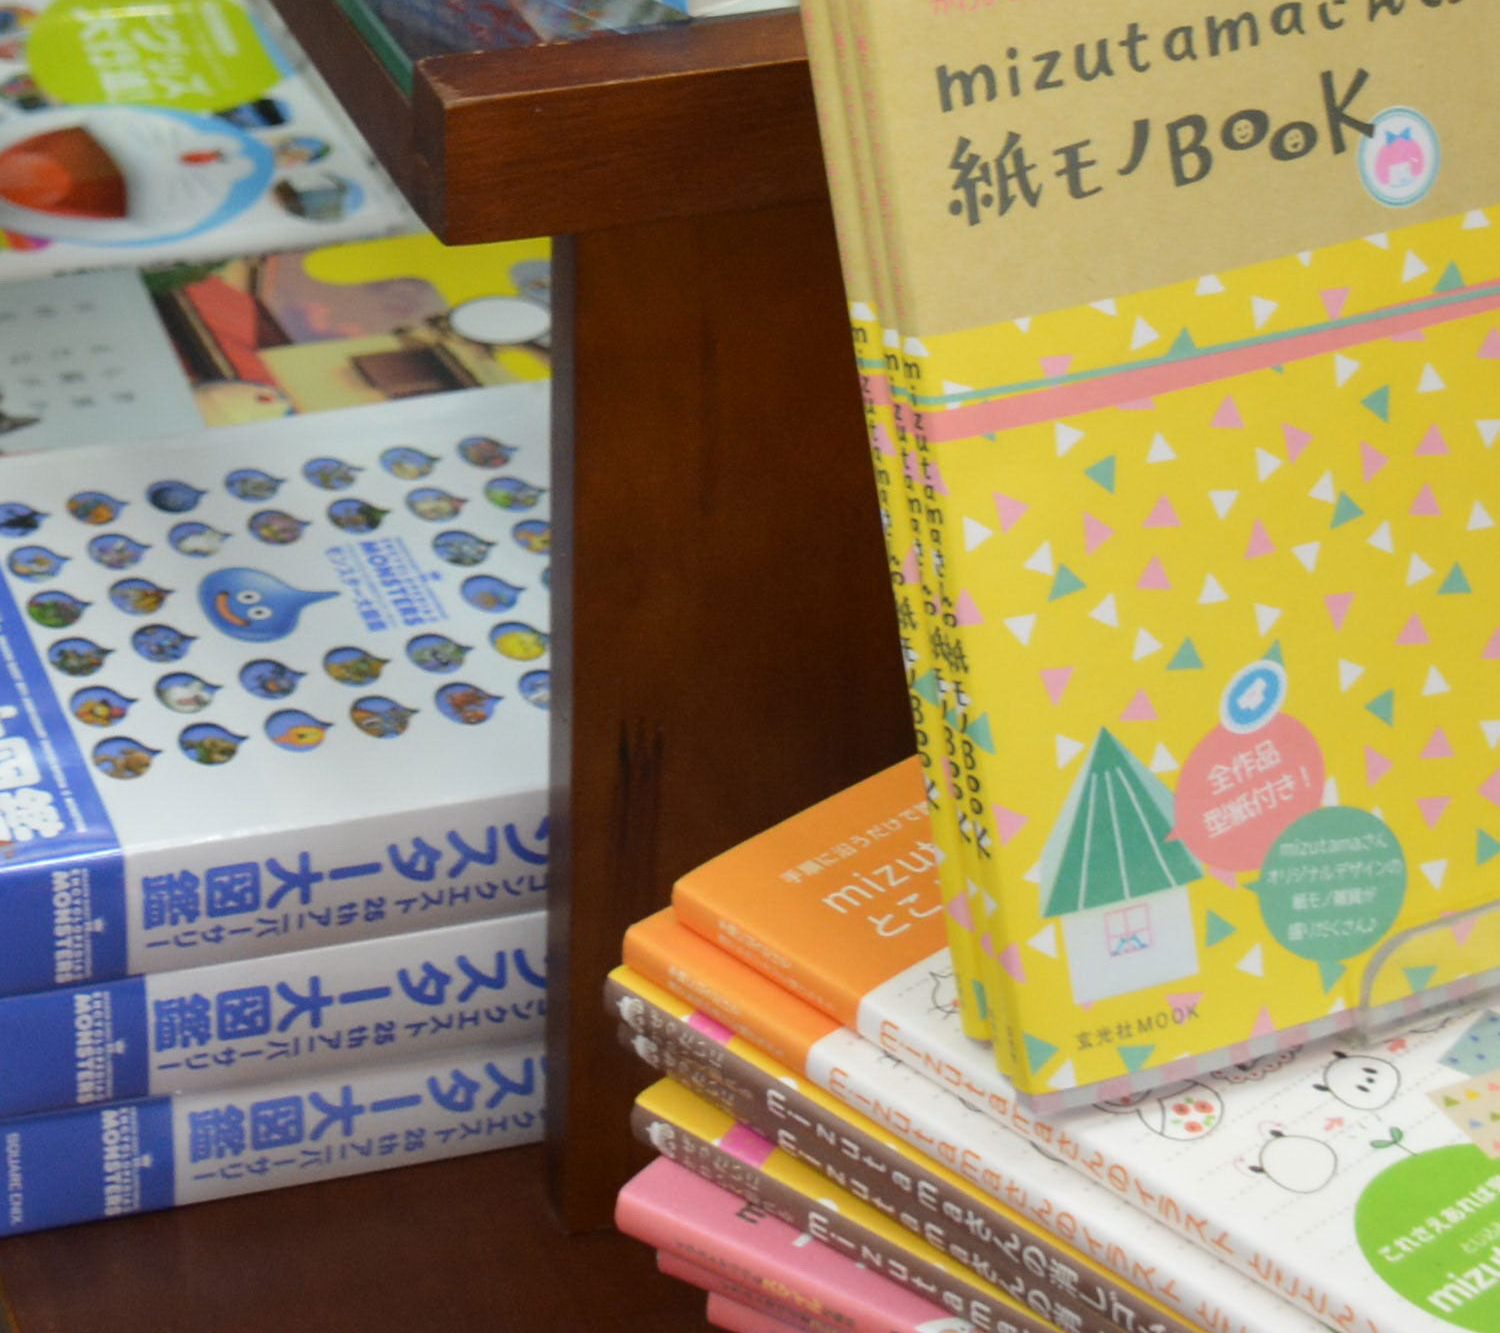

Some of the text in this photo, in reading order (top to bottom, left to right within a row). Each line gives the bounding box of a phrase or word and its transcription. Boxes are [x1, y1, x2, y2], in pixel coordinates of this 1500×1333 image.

[1204, 738, 1285, 798] 全作品
[50, 869, 70, 984] MONSTERS
[73, 993, 92, 1106] MONSTERS
[100, 1109, 119, 1218] MONSTERS
[187, 1053, 549, 1165] スター大図鑑
